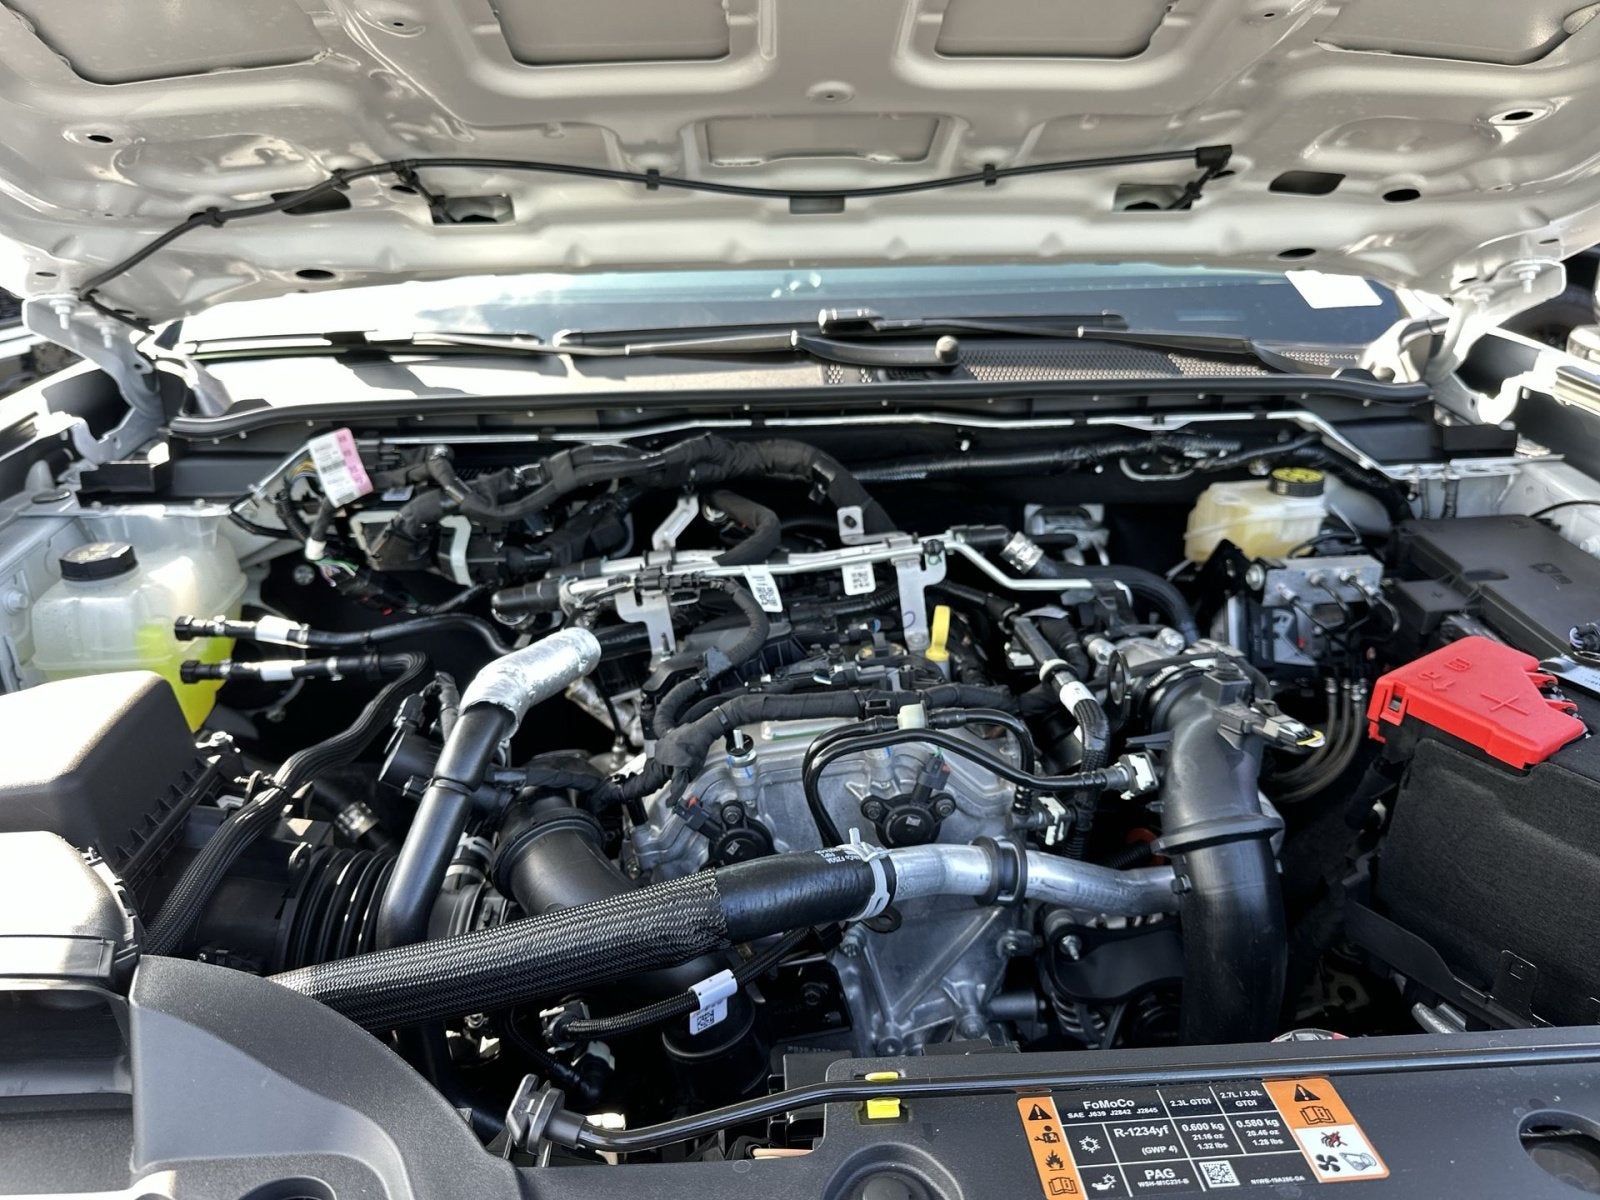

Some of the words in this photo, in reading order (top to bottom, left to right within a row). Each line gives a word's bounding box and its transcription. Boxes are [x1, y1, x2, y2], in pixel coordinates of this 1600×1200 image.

[1220, 1091, 1238, 1099] 2.7L
[1082, 1099, 1135, 1110] FoMoCo
[1235, 1099, 1258, 1107] GTDI
[1088, 1110, 1107, 1118] J639
[1181, 1122, 1210, 1132] 0.600
[1210, 1122, 1226, 1131] kg
[1235, 1119, 1264, 1128] 0.580
[1264, 1119, 1280, 1127] kg
[1113, 1125, 1169, 1138] R-1234yf
[1141, 1145, 1167, 1156] (GWP
[1168, 1145, 1179, 1154] 4)
[1197, 1142, 1214, 1150] 1.32
[1144, 1167, 1176, 1180] PAG
